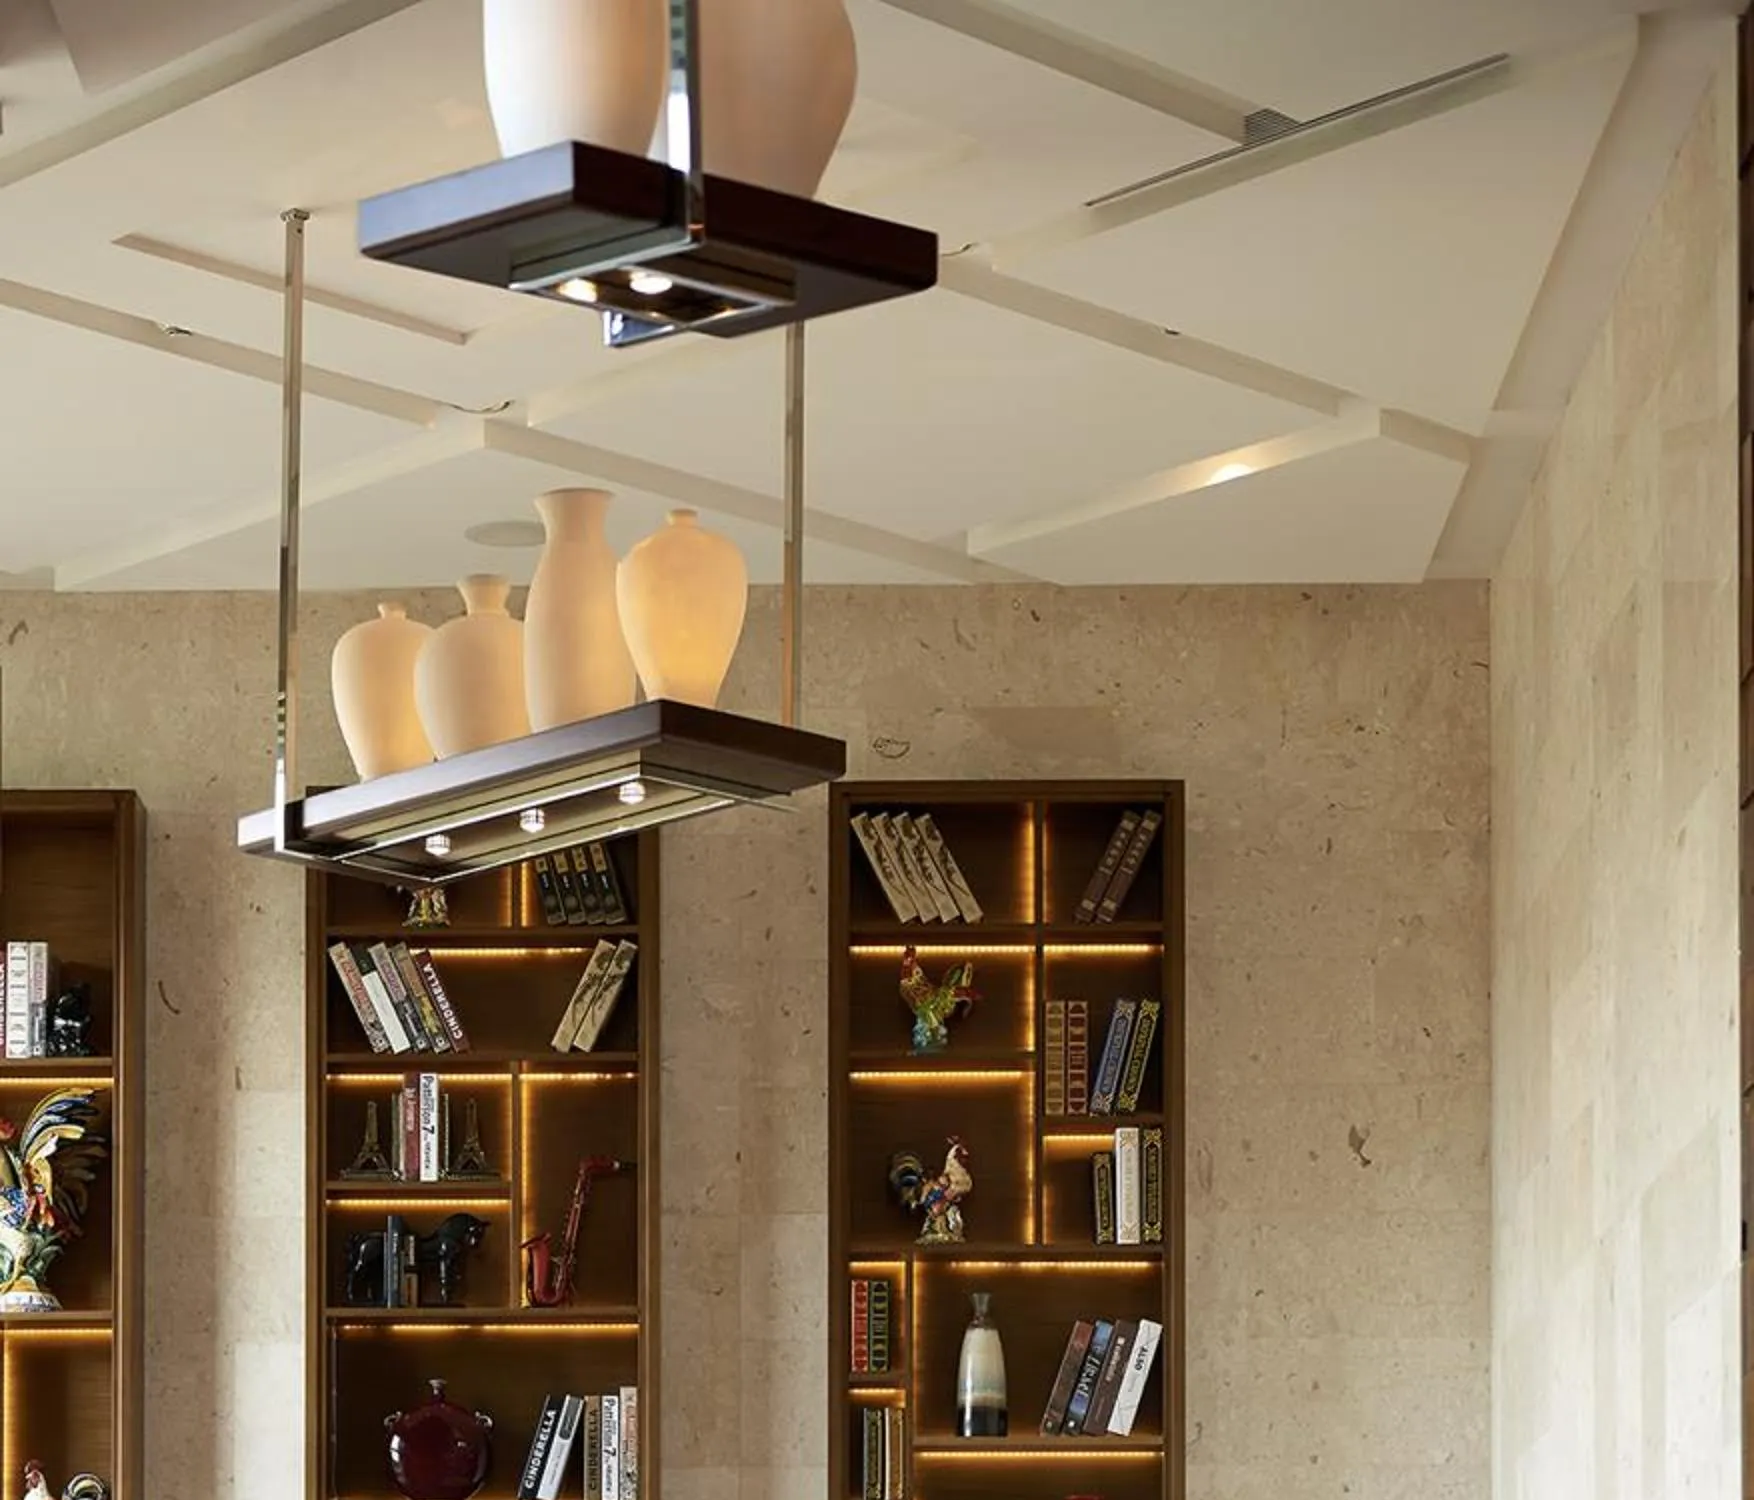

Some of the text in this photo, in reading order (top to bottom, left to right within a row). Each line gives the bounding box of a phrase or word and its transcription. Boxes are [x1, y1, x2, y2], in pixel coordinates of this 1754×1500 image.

[423, 962, 463, 1040] CINDERELLA
[525, 1409, 557, 1489] CINDERELLA
[587, 1409, 597, 1490] CINDERELLA
